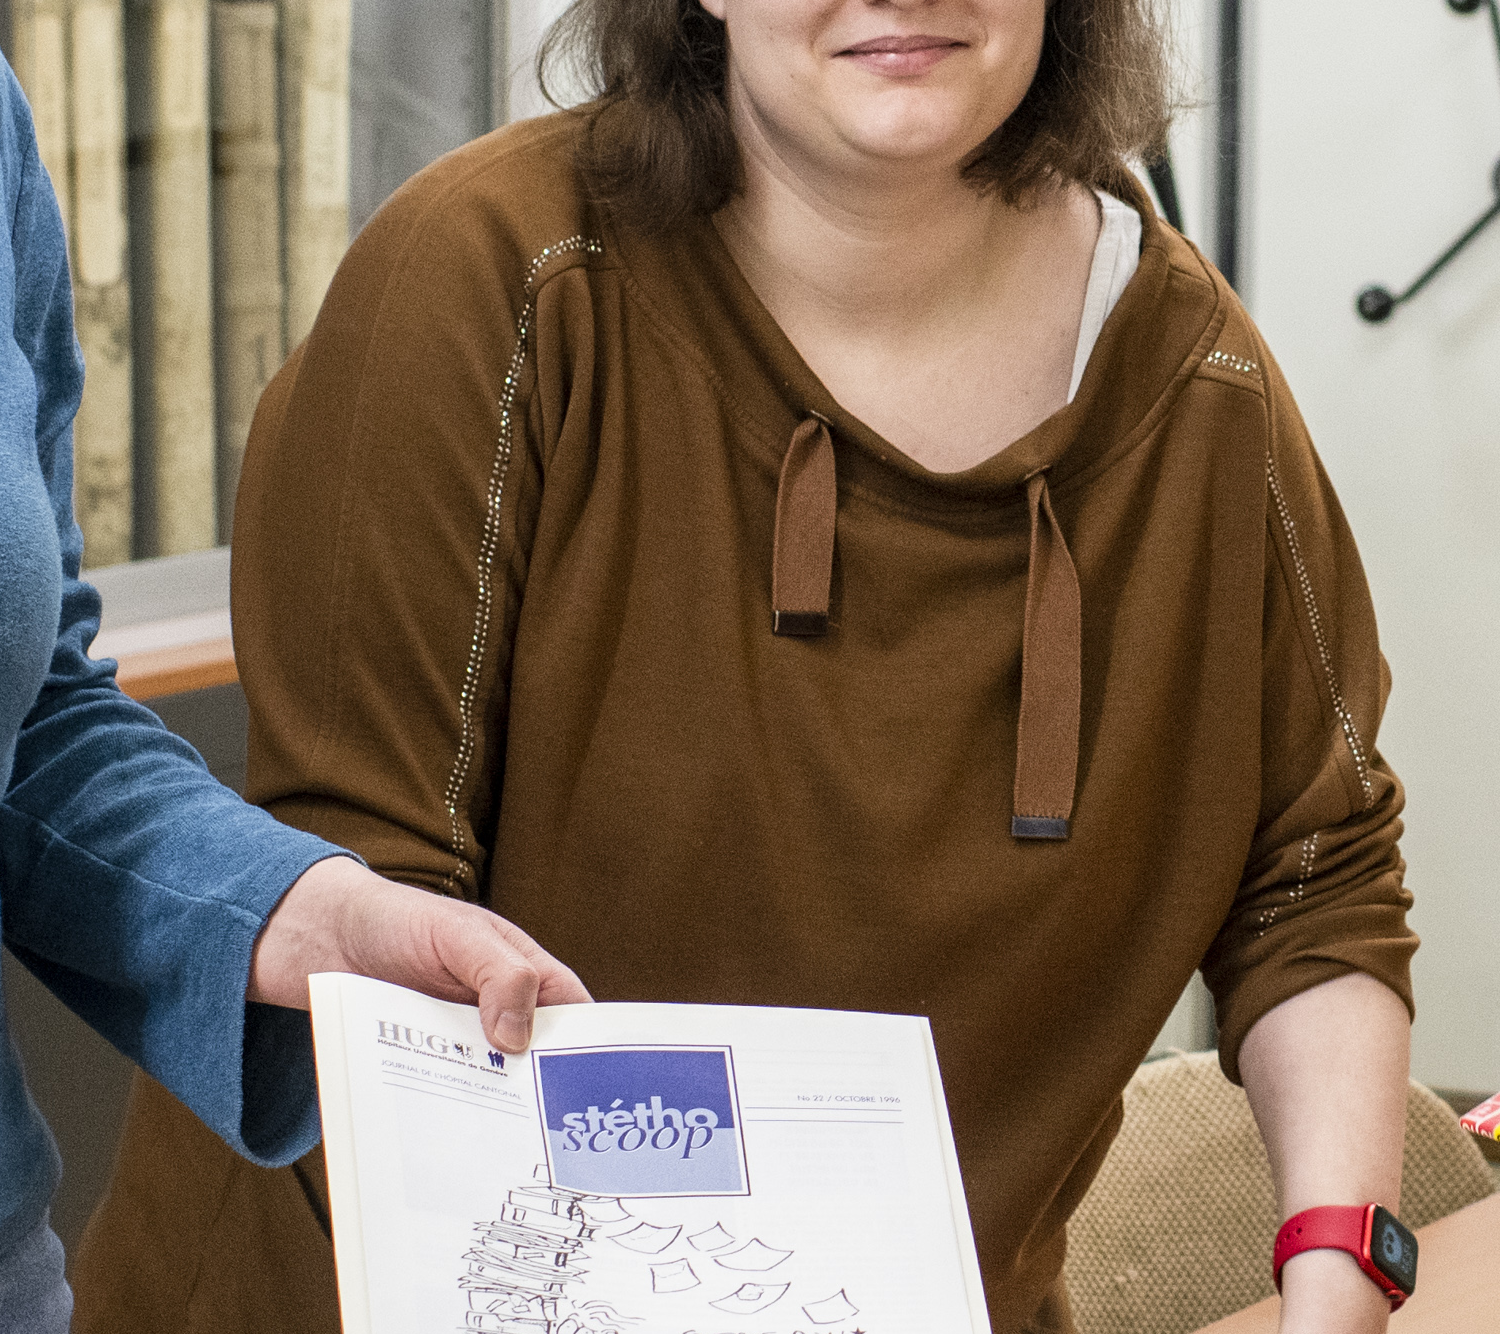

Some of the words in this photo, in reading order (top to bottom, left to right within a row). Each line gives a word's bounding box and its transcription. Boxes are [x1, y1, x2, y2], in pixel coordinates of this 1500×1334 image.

[376, 1020, 450, 1055] HUG
[377, 1038, 411, 1052] Hôpitaux
[414, 1048, 466, 1066] Universitaires
[480, 1065, 508, 1077] Genève
[381, 1059, 419, 1074] JOURNAL
[422, 1068, 432, 1076] DE
[434, 1072, 472, 1087] L'HÔPITAL
[475, 1082, 521, 1100] CANTONAL
[563, 1096, 719, 1133] stétho
[812, 1094, 825, 1103] 22
[835, 1094, 876, 1103] OCTOBRE
[879, 1095, 902, 1104] 1996
[563, 1125, 715, 1160] scoop
